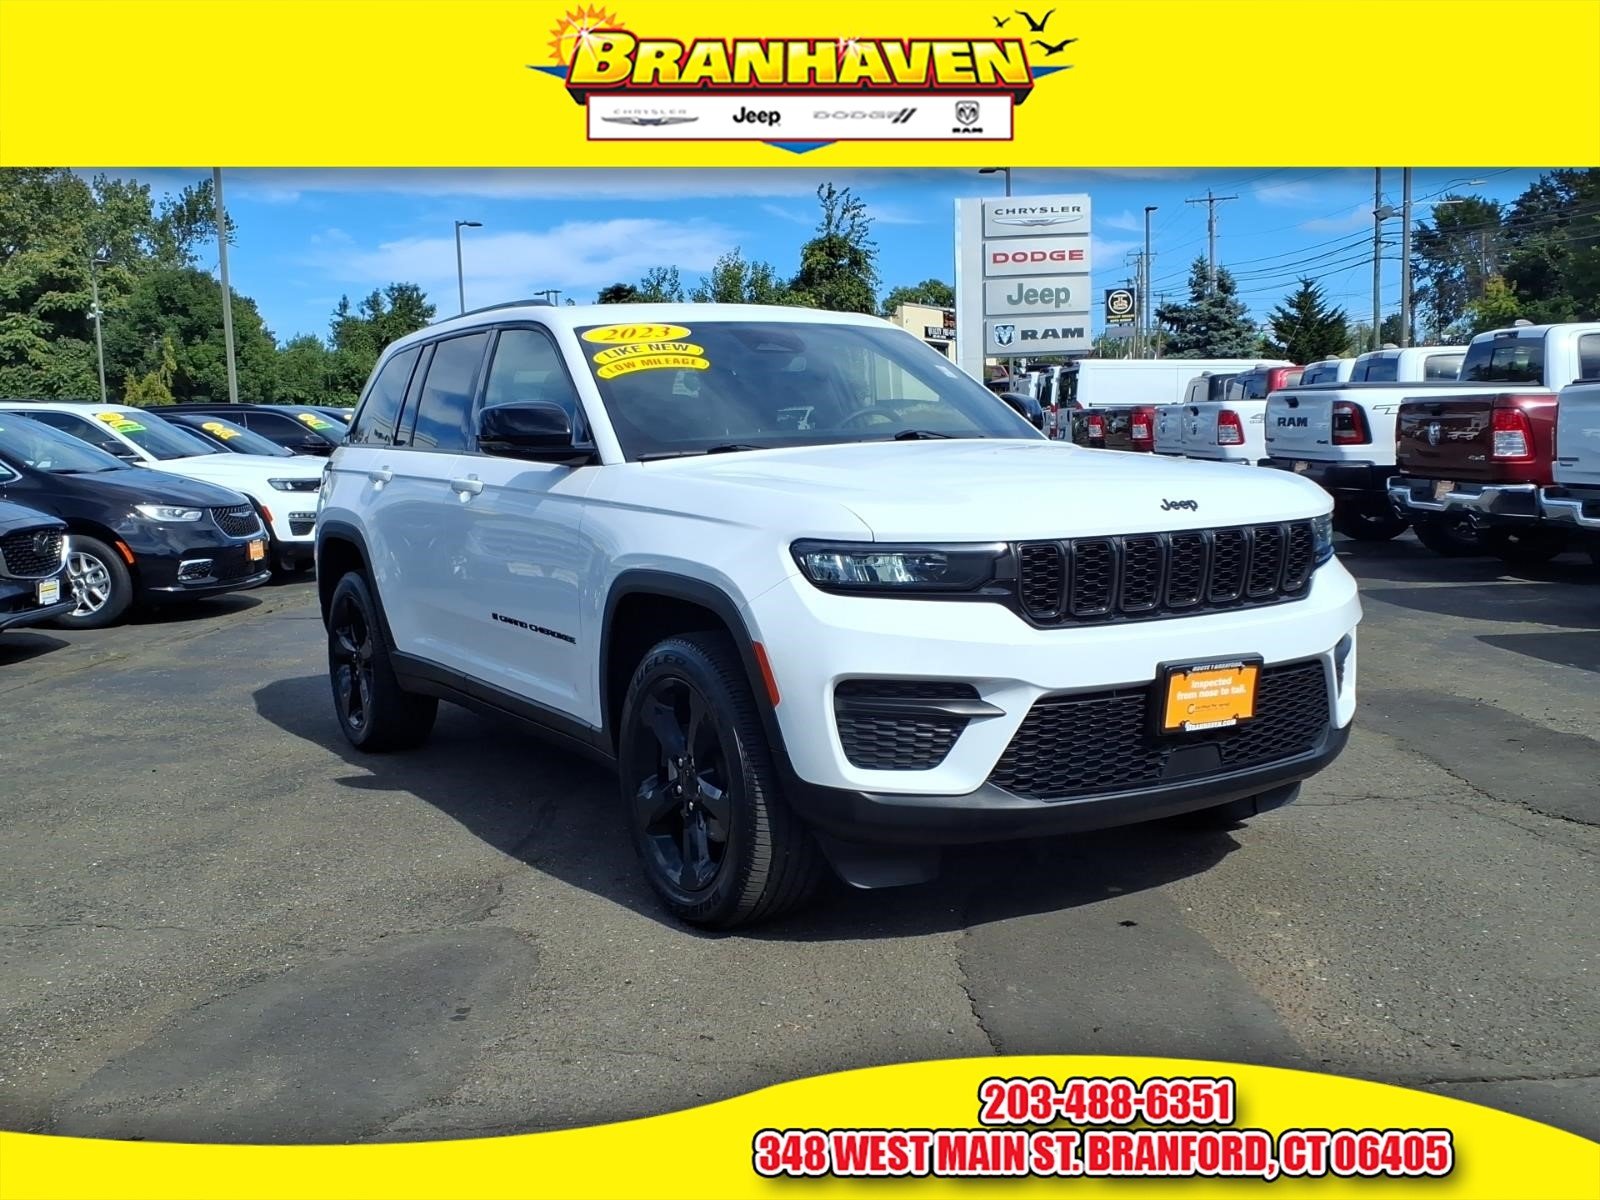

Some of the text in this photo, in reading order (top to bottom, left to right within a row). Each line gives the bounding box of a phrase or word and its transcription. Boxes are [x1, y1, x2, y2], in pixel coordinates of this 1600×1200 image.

[994, 205, 1081, 216] CHRYSLER
[992, 249, 1084, 264] DODGE
[1006, 282, 1071, 309] Jeep
[602, 327, 671, 340] 2023
[1020, 327, 1085, 341] RAM
[604, 343, 689, 359] LIKE NEW
[607, 358, 698, 374] LOW MILEAGE
[1276, 416, 1309, 428] RAM
[1160, 498, 1199, 512] Jeep
